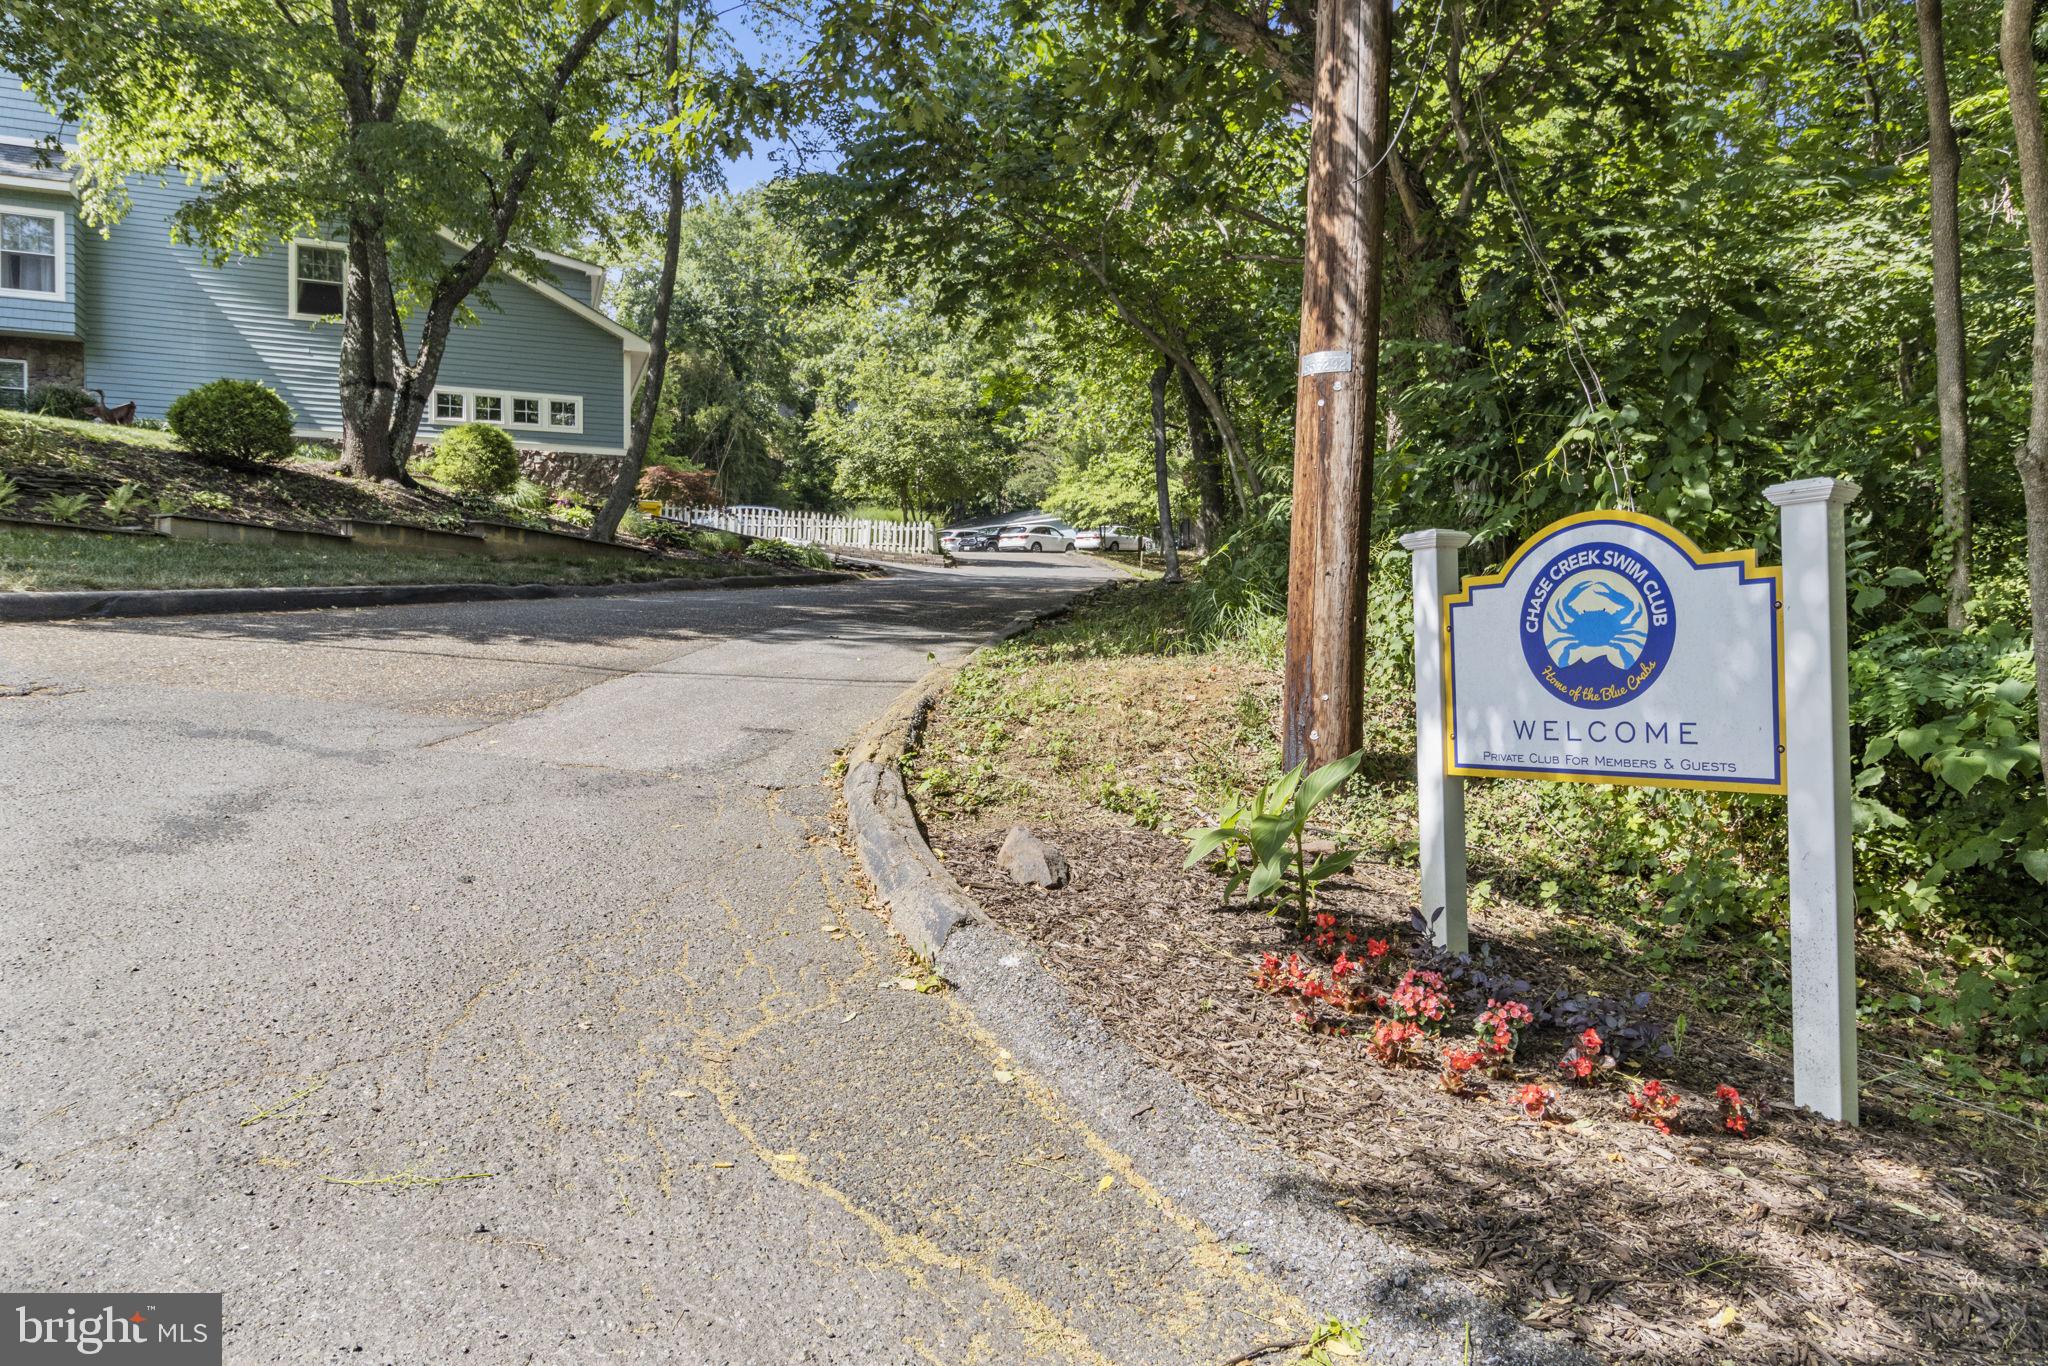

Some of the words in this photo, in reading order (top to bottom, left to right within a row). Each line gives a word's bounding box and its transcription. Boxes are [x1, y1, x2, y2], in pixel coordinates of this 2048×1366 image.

[1526, 577, 1553, 633] CHASE
[1550, 549, 1600, 581] CREEK
[1602, 551, 1648, 583] SWIM
[1643, 580, 1668, 627] CLUB
[1542, 665, 1568, 693] Home
[1569, 686, 1581, 702] of
[1582, 688, 1600, 701] the
[1600, 685, 1627, 701] Blue
[1627, 660, 1656, 691] Crabs
[1513, 719, 1698, 745] WELCOME
[1663, 758, 1675, 770] &
